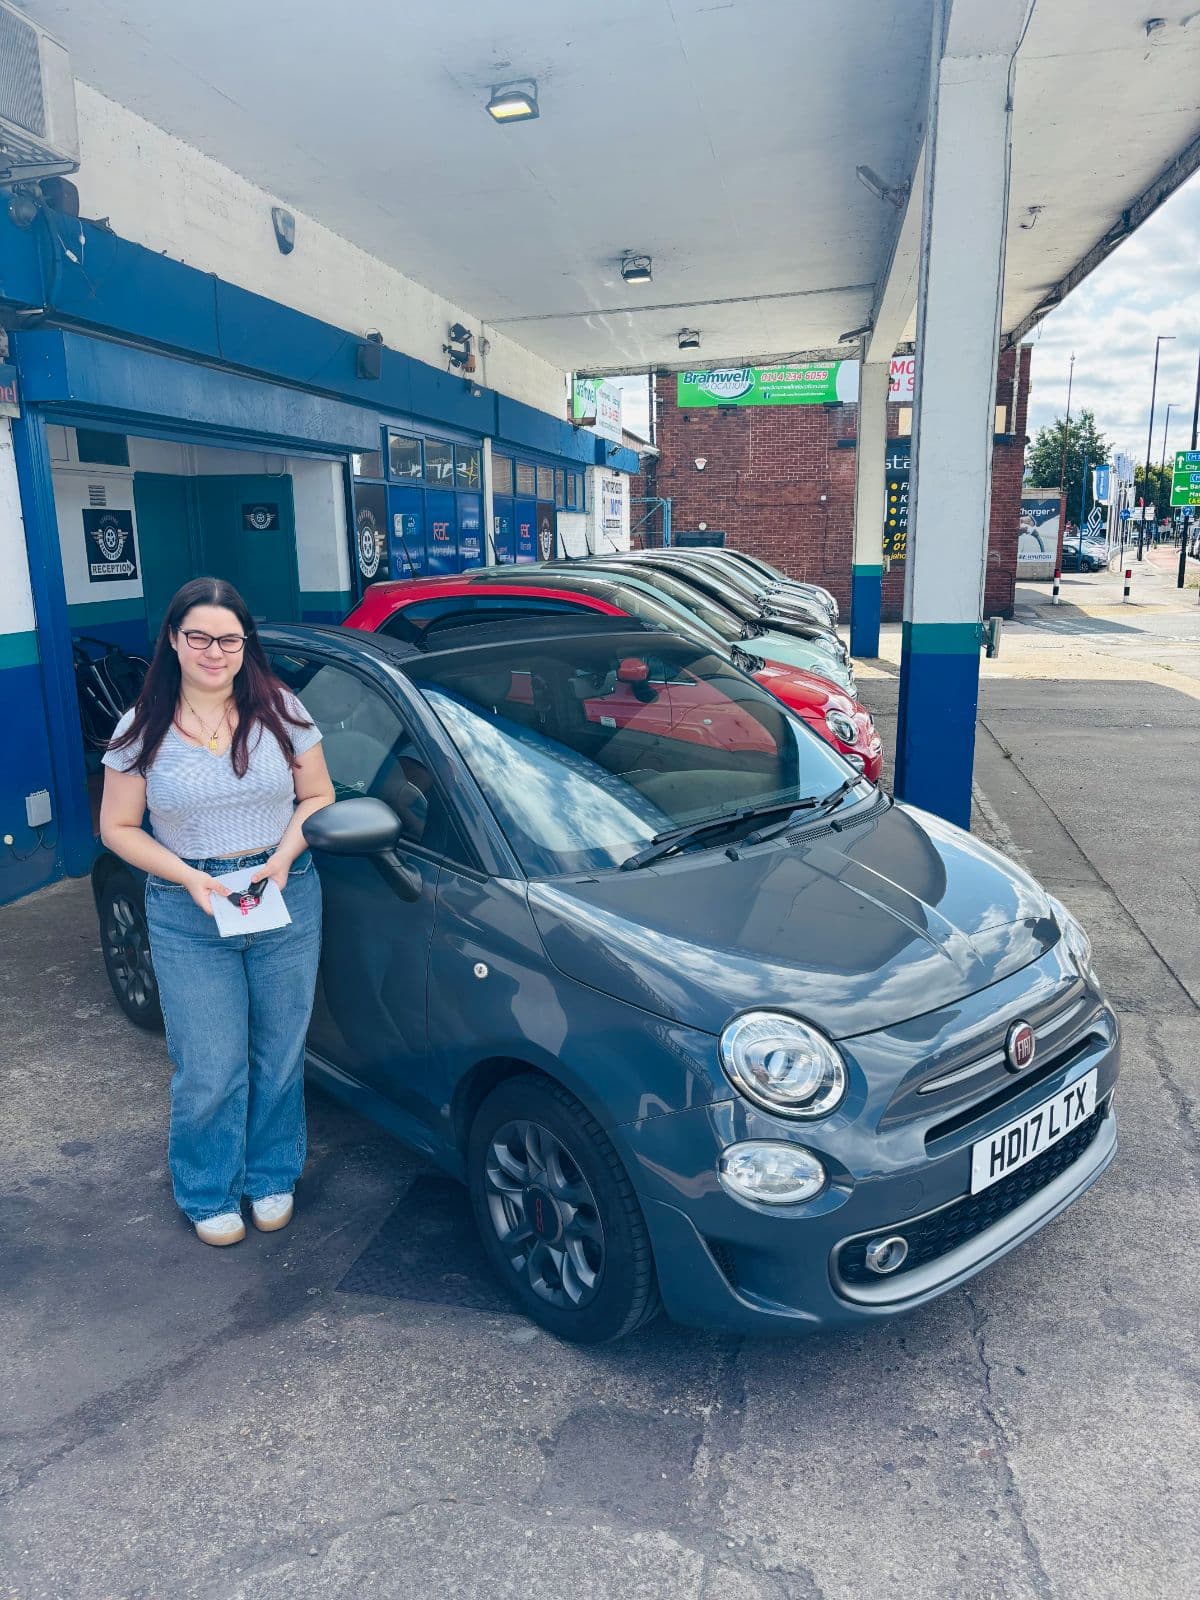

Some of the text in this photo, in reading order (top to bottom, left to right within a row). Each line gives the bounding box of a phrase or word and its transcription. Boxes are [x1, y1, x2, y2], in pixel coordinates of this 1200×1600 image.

[683, 369, 750, 384] Bramwell
[761, 373, 783, 382] 0114
[785, 372, 802, 381] 234
[92, 564, 132, 574] RECEPTION
[1017, 1036, 1031, 1061] FIAT
[989, 1081, 1087, 1178] HD17 LTX
